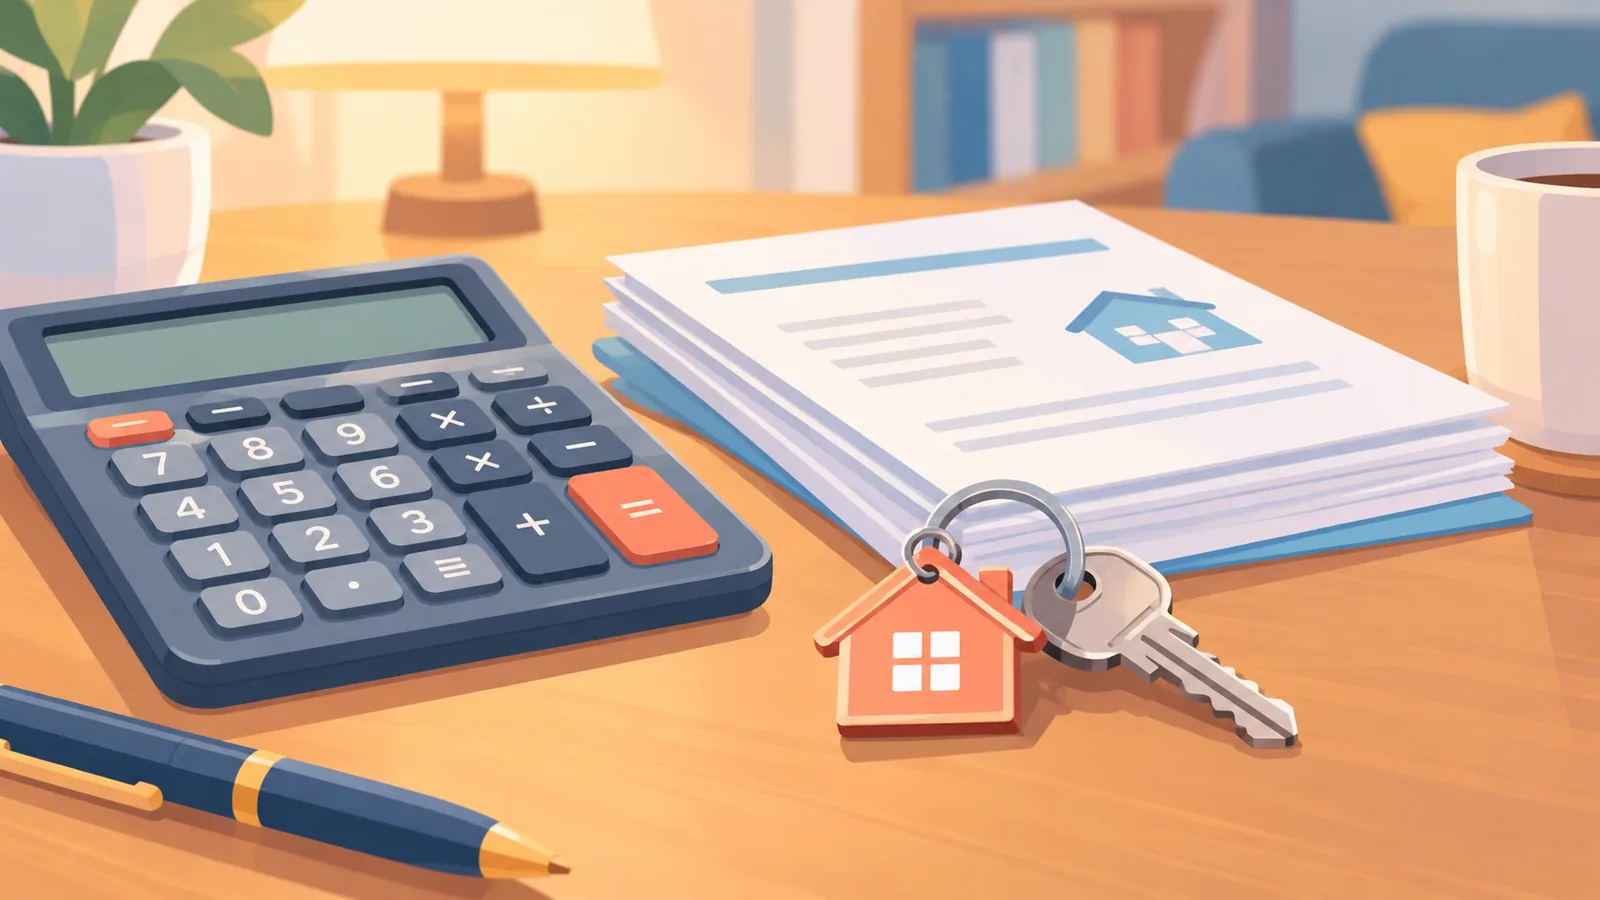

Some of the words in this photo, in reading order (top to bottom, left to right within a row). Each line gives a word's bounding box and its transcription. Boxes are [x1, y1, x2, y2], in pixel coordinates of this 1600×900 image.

[336, 422, 367, 446] 9
[242, 436, 275, 461] 8
[141, 451, 168, 477] 7
[369, 464, 401, 490] 6
[271, 479, 305, 505] 5
[176, 495, 207, 520] 4
[400, 509, 435, 535] 3
[304, 525, 340, 552] 2
[206, 541, 233, 567] 1
[234, 588, 268, 616] 0
